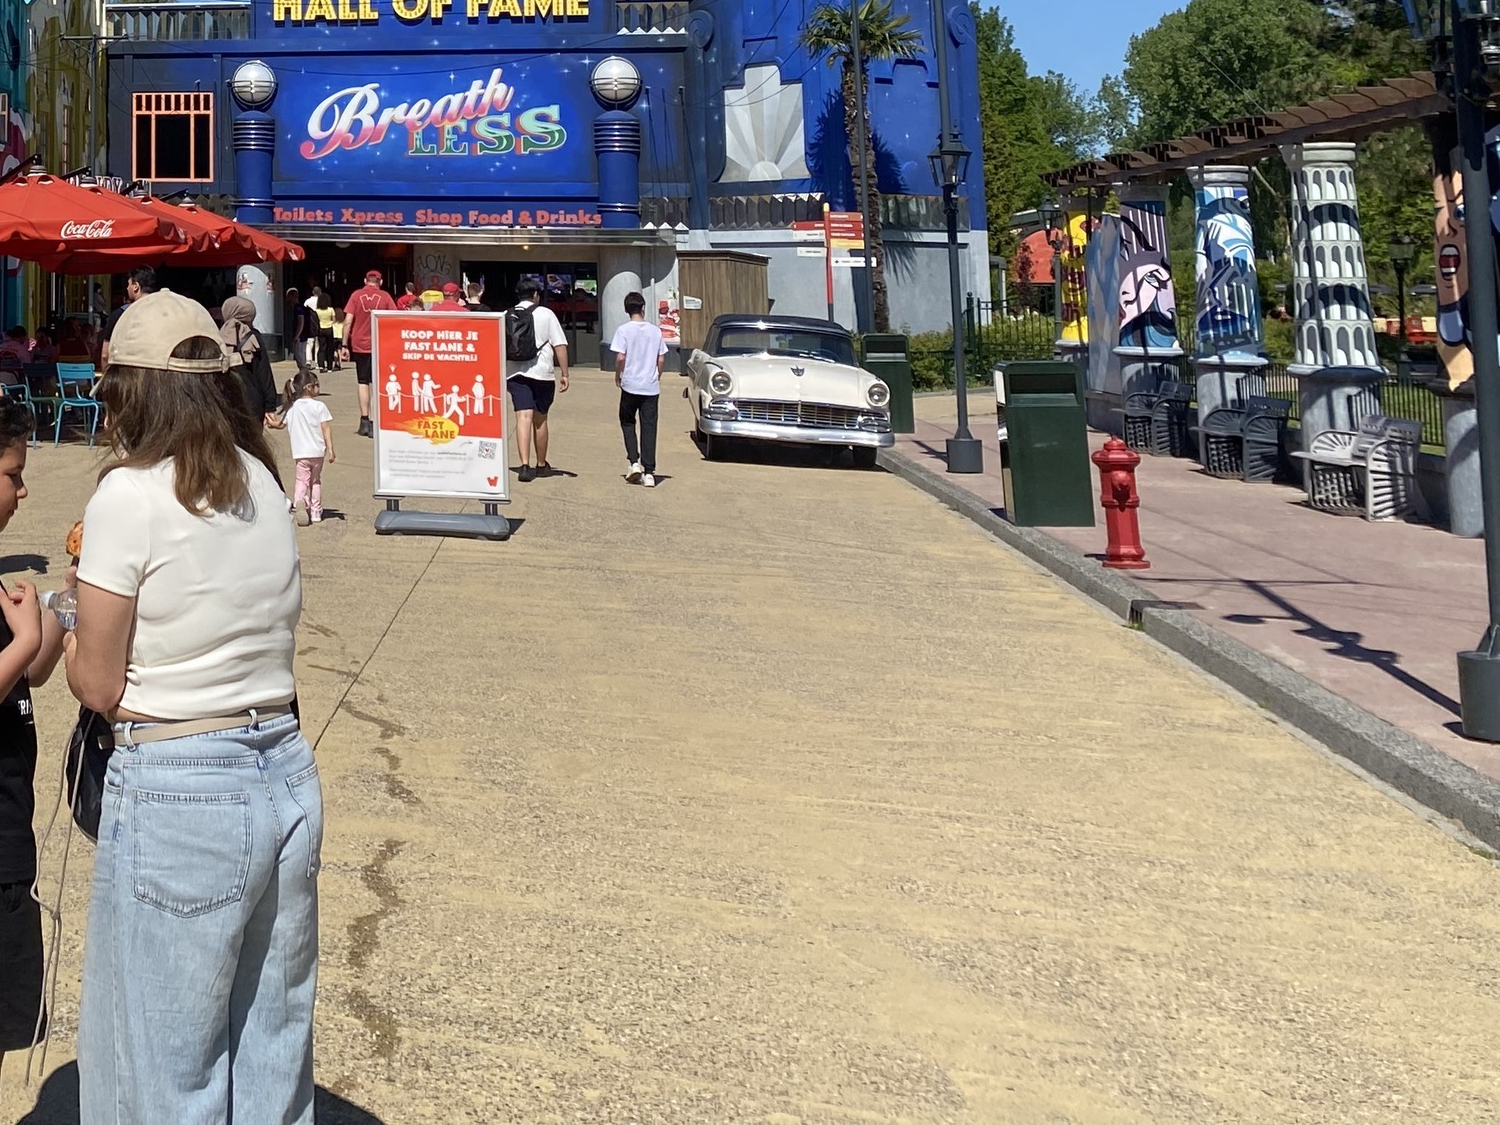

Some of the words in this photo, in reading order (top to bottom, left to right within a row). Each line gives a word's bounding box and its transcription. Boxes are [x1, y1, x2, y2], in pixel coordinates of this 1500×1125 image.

[299, 67, 516, 160] Breath
[405, 104, 568, 157] LESS
[273, 208, 333, 224] Toilets
[340, 208, 404, 226] Xpress
[415, 209, 463, 227] Shop
[468, 210, 514, 225] Food
[518, 210, 533, 226] &
[536, 209, 602, 226] Drinks
[60, 219, 116, 240] Coca-Cola
[401, 329, 434, 340] KOOP
[404, 341, 431, 351] FAST
[433, 342, 463, 352] LANE
[466, 343, 476, 352] &
[423, 353, 435, 361] DE
[417, 420, 445, 431] FAST
[425, 429, 456, 440] LANE
